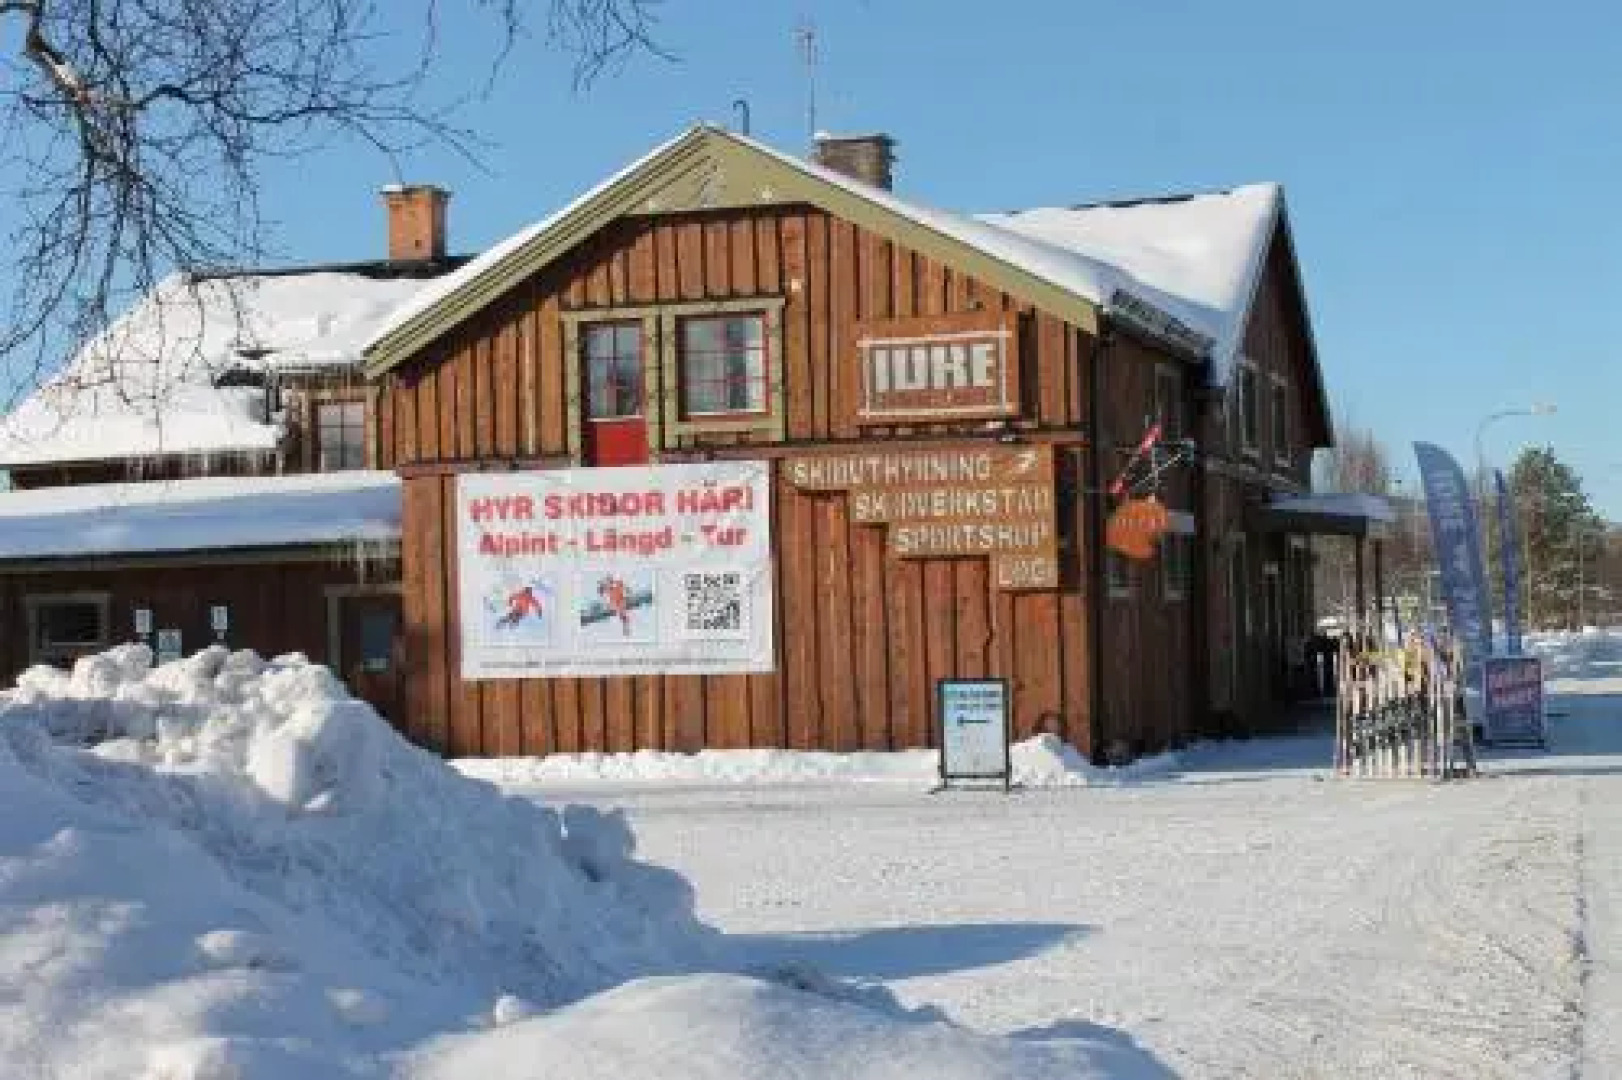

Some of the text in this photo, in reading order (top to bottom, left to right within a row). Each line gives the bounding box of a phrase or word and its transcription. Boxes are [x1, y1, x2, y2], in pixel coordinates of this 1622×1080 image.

[544, 490, 666, 519] SKIDOR
[479, 530, 558, 557] Alpint
[586, 525, 674, 555] Längd
[700, 523, 747, 547] Tur
